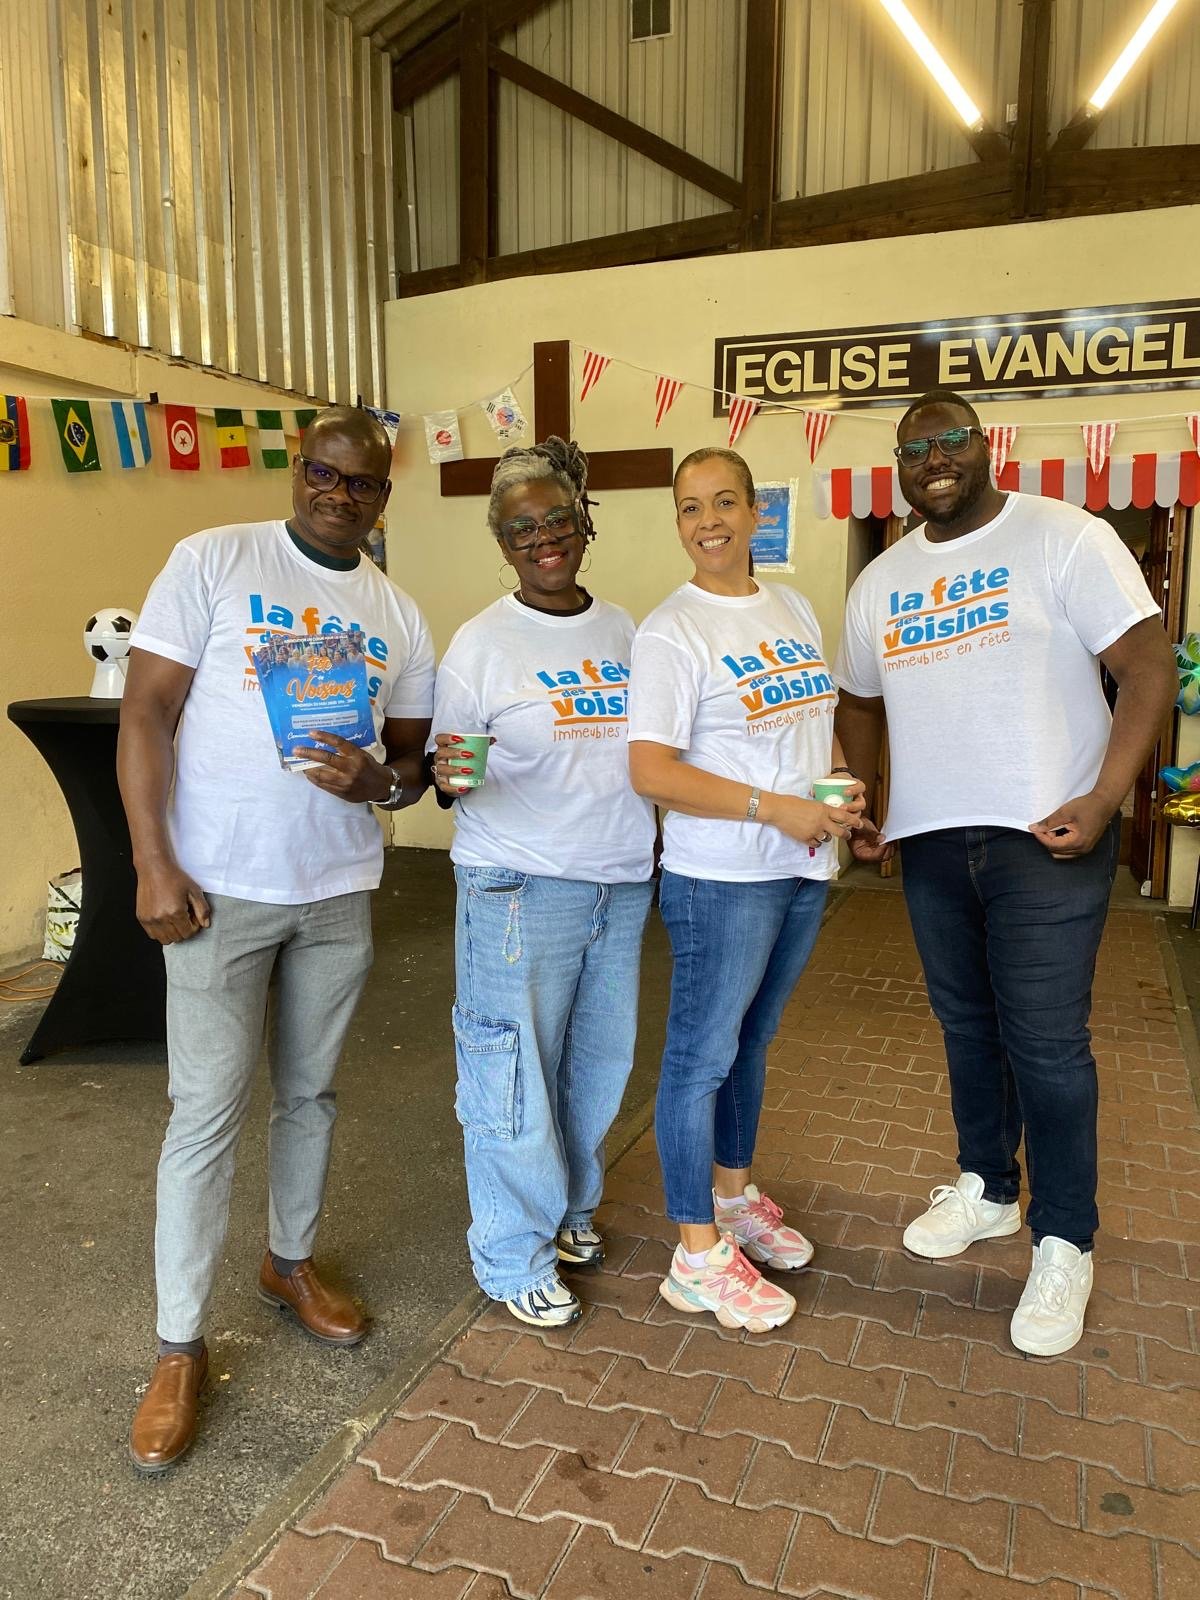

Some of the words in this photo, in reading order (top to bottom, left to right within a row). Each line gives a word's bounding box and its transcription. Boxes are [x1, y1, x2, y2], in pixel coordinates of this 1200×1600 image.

[735, 343, 911, 396] EGLISE
[938, 322, 1200, 384] EVANGEL
[890, 591, 924, 617] la
[931, 566, 1010, 607] fête
[249, 594, 294, 630] la
[883, 602, 1009, 651] voisins
[894, 614, 920, 629] des
[957, 642, 972, 656] en
[979, 630, 1011, 649] fête
[721, 655, 765, 679] la
[758, 638, 821, 667] fête
[286, 673, 357, 703] Voisins
[536, 670, 581, 689] la
[561, 688, 586, 698] des
[749, 673, 772, 690] des
